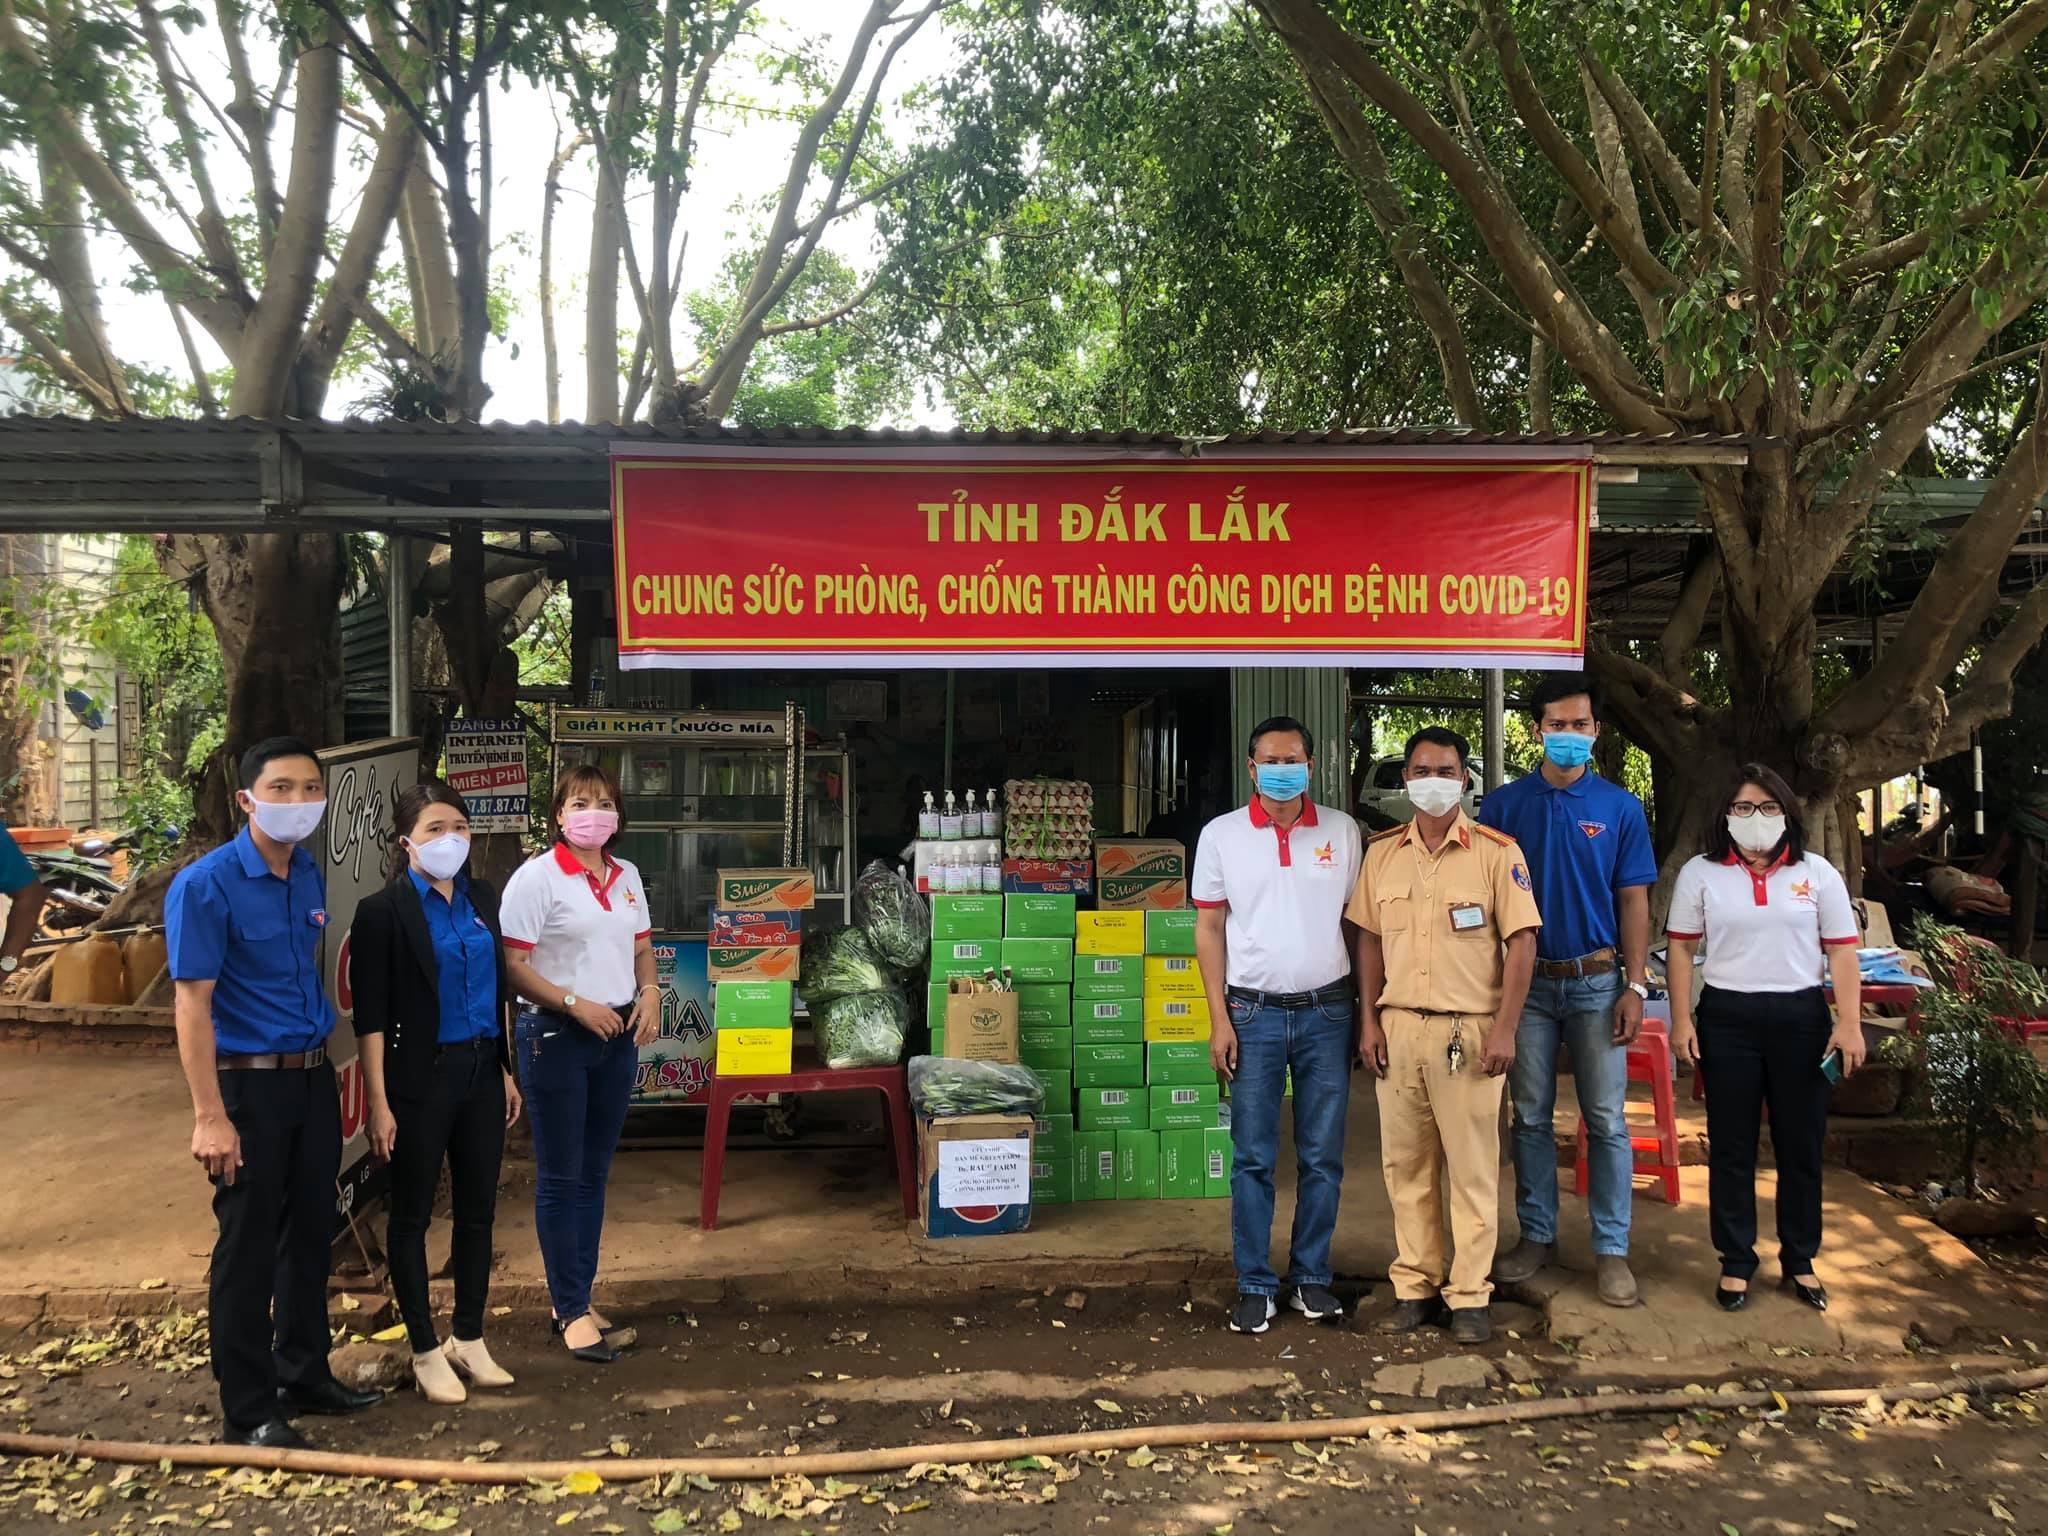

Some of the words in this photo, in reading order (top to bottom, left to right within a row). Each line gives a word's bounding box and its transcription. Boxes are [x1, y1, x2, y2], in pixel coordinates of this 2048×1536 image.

[917, 489, 1038, 542] TỈNH
[1059, 486, 1168, 542] ĐẮK
[1189, 486, 1291, 542] LẮK
[633, 574, 734, 615] CHUNG
[743, 563, 804, 615] SỨC
[816, 563, 927, 623] PHÒNG,
[938, 559, 1043, 615] CHỐNG
[1052, 563, 1156, 614] THÀNH
[1167, 563, 1250, 614] CÔNG
[1262, 574, 1333, 623] DỊCH
[1345, 563, 1428, 622] BỆNH
[1439, 574, 1571, 617] COVID-19
[449, 734, 525, 747] INTERNET
[614, 719, 667, 732] KHÁT
[680, 721, 734, 732] NƯỚC
[740, 721, 775, 733] MÍA
[449, 748, 484, 764] TRUYỀN
[512, 751, 524, 763] HD
[329, 765, 383, 882] Cafe
